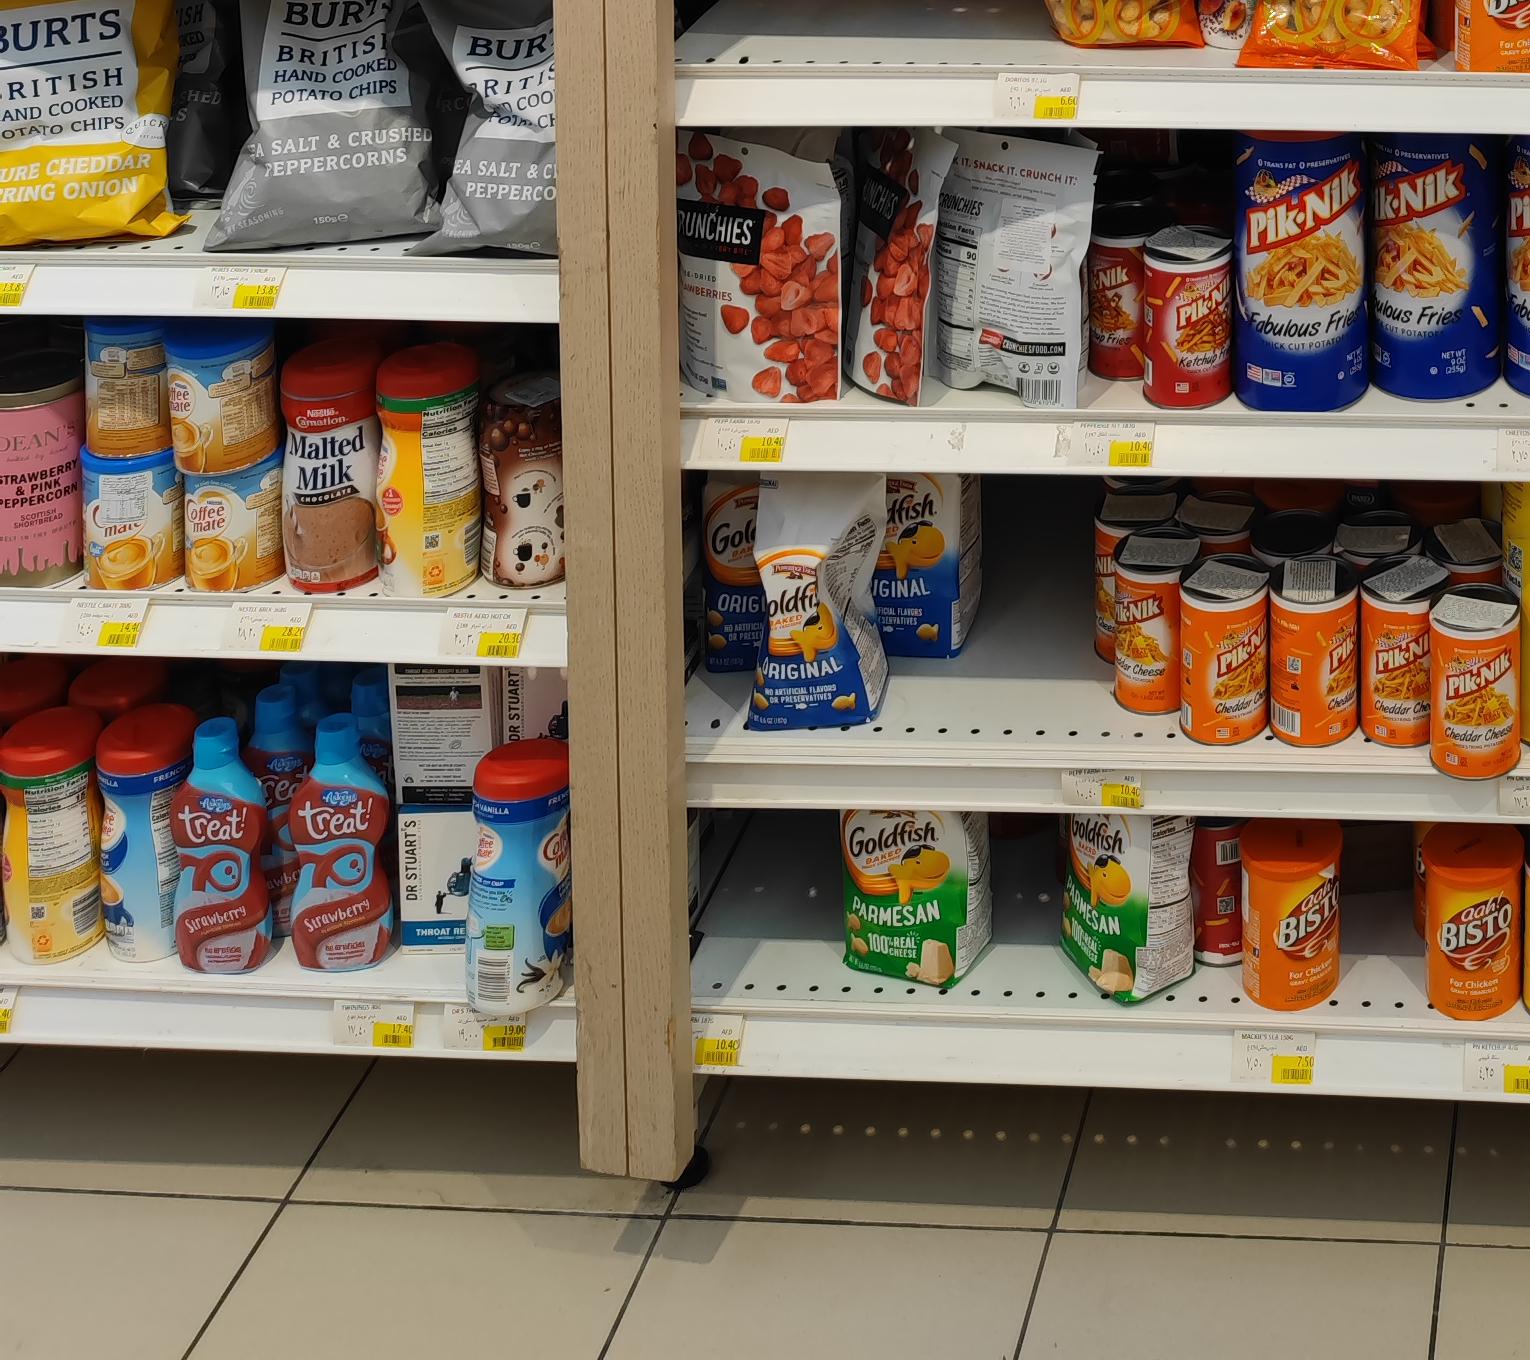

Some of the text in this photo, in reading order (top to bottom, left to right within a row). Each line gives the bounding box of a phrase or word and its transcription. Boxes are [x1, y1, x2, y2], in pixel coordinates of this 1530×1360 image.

[270, 125, 432, 154] SALT & CRUSHED
[49, 151, 152, 175] CHEDDAR
[266, 148, 407, 178] PEPPERCORNS
[974, 160, 1060, 183] SNACK CRUNCH
[68, 178, 137, 198] ONION
[1249, 300, 1357, 338] Fabulous Fries
[1003, 339, 1064, 353] CRUNCHIESFOOD.COM
[289, 427, 365, 461] Malted
[16, 477, 61, 496] & PINK
[298, 459, 354, 492] Milk
[300, 485, 357, 505] CHOCOLATE
[14, 513, 63, 529] SHORTBREAD
[21, 508, 56, 522] SCOTTISH
[178, 805, 248, 841] treat!
[848, 822, 936, 858] Goldfish
[401, 819, 418, 901] DR STUART'S
[186, 906, 248, 932] Strawberry
[853, 898, 940, 924] PARMESAN
[1441, 905, 1513, 951] BISTO
